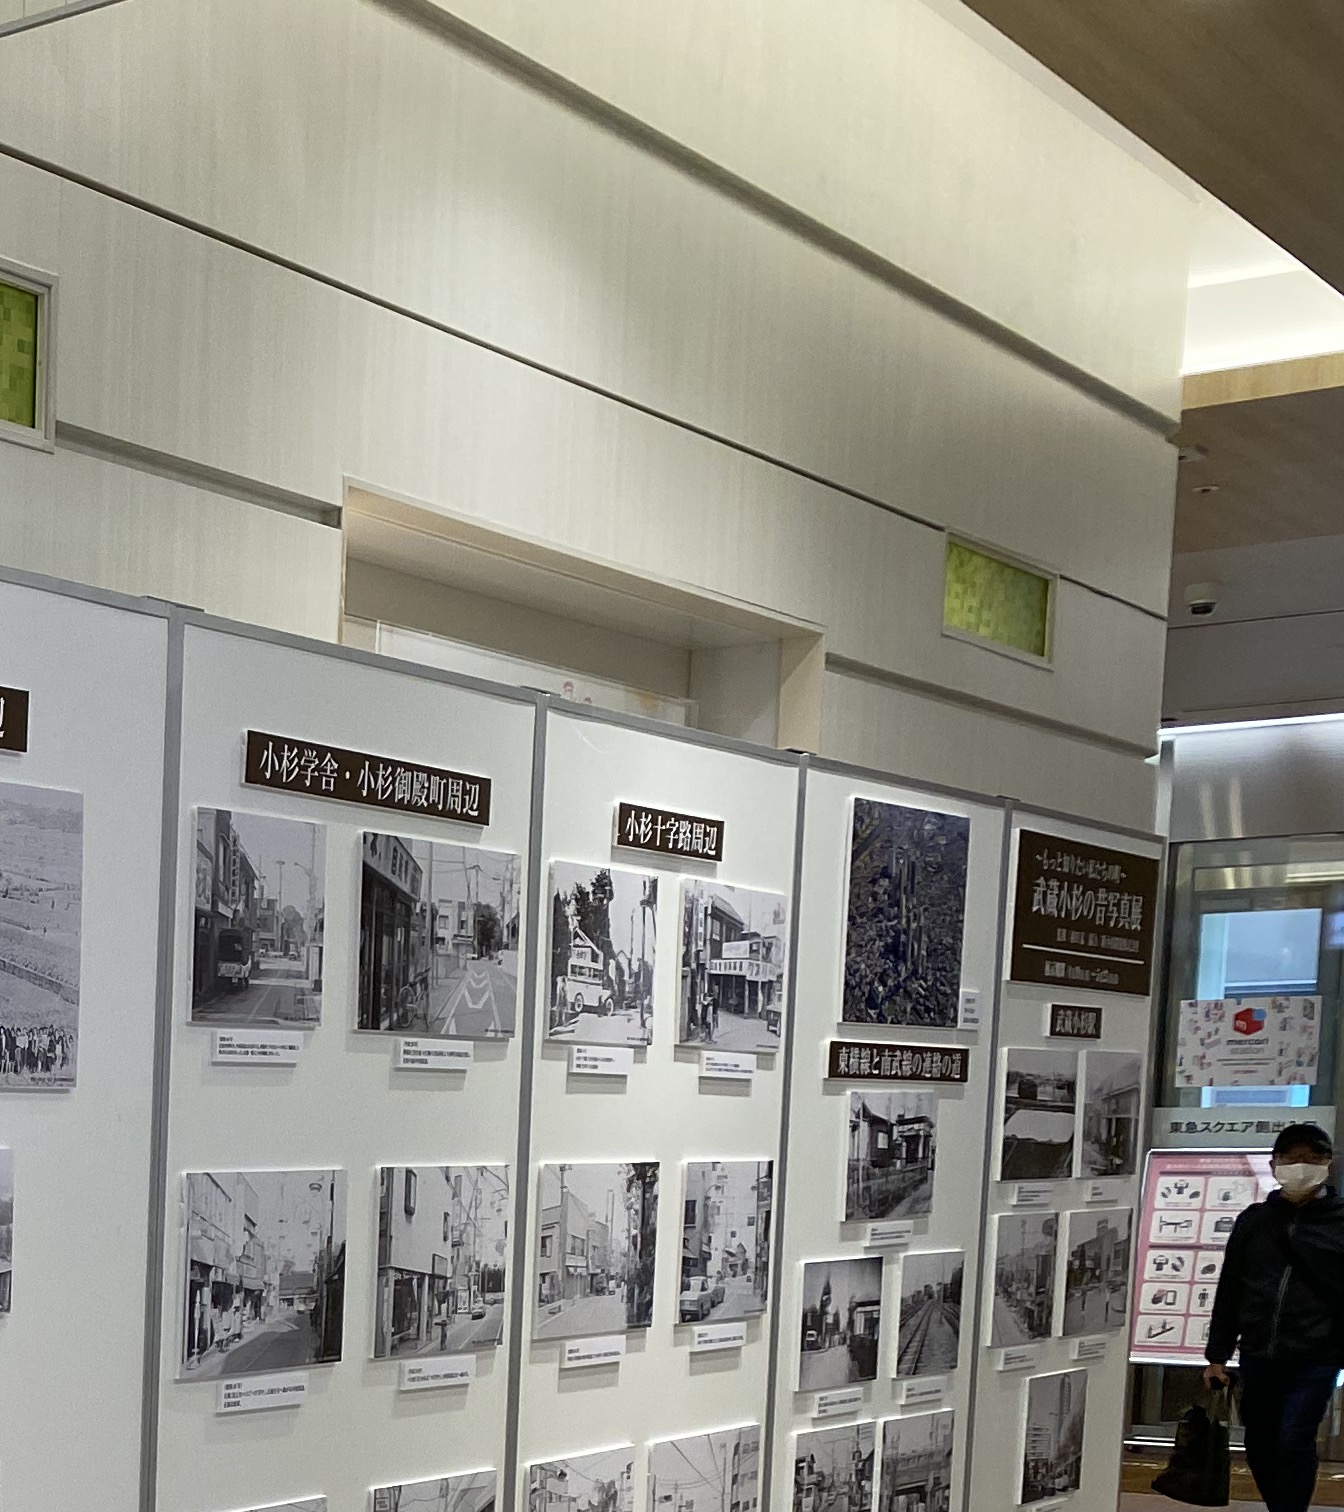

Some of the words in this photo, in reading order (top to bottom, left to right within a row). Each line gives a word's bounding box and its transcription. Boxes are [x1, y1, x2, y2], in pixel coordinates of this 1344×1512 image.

[259, 740, 480, 816] 小杉学舎・小杉御殿町周辺
[625, 810, 718, 856] 小杉十字路周辺
[1032, 875, 1143, 931] 武蔵小杉の昔写真展
[1169, 1121, 1317, 1134] 東急スクエア側出
